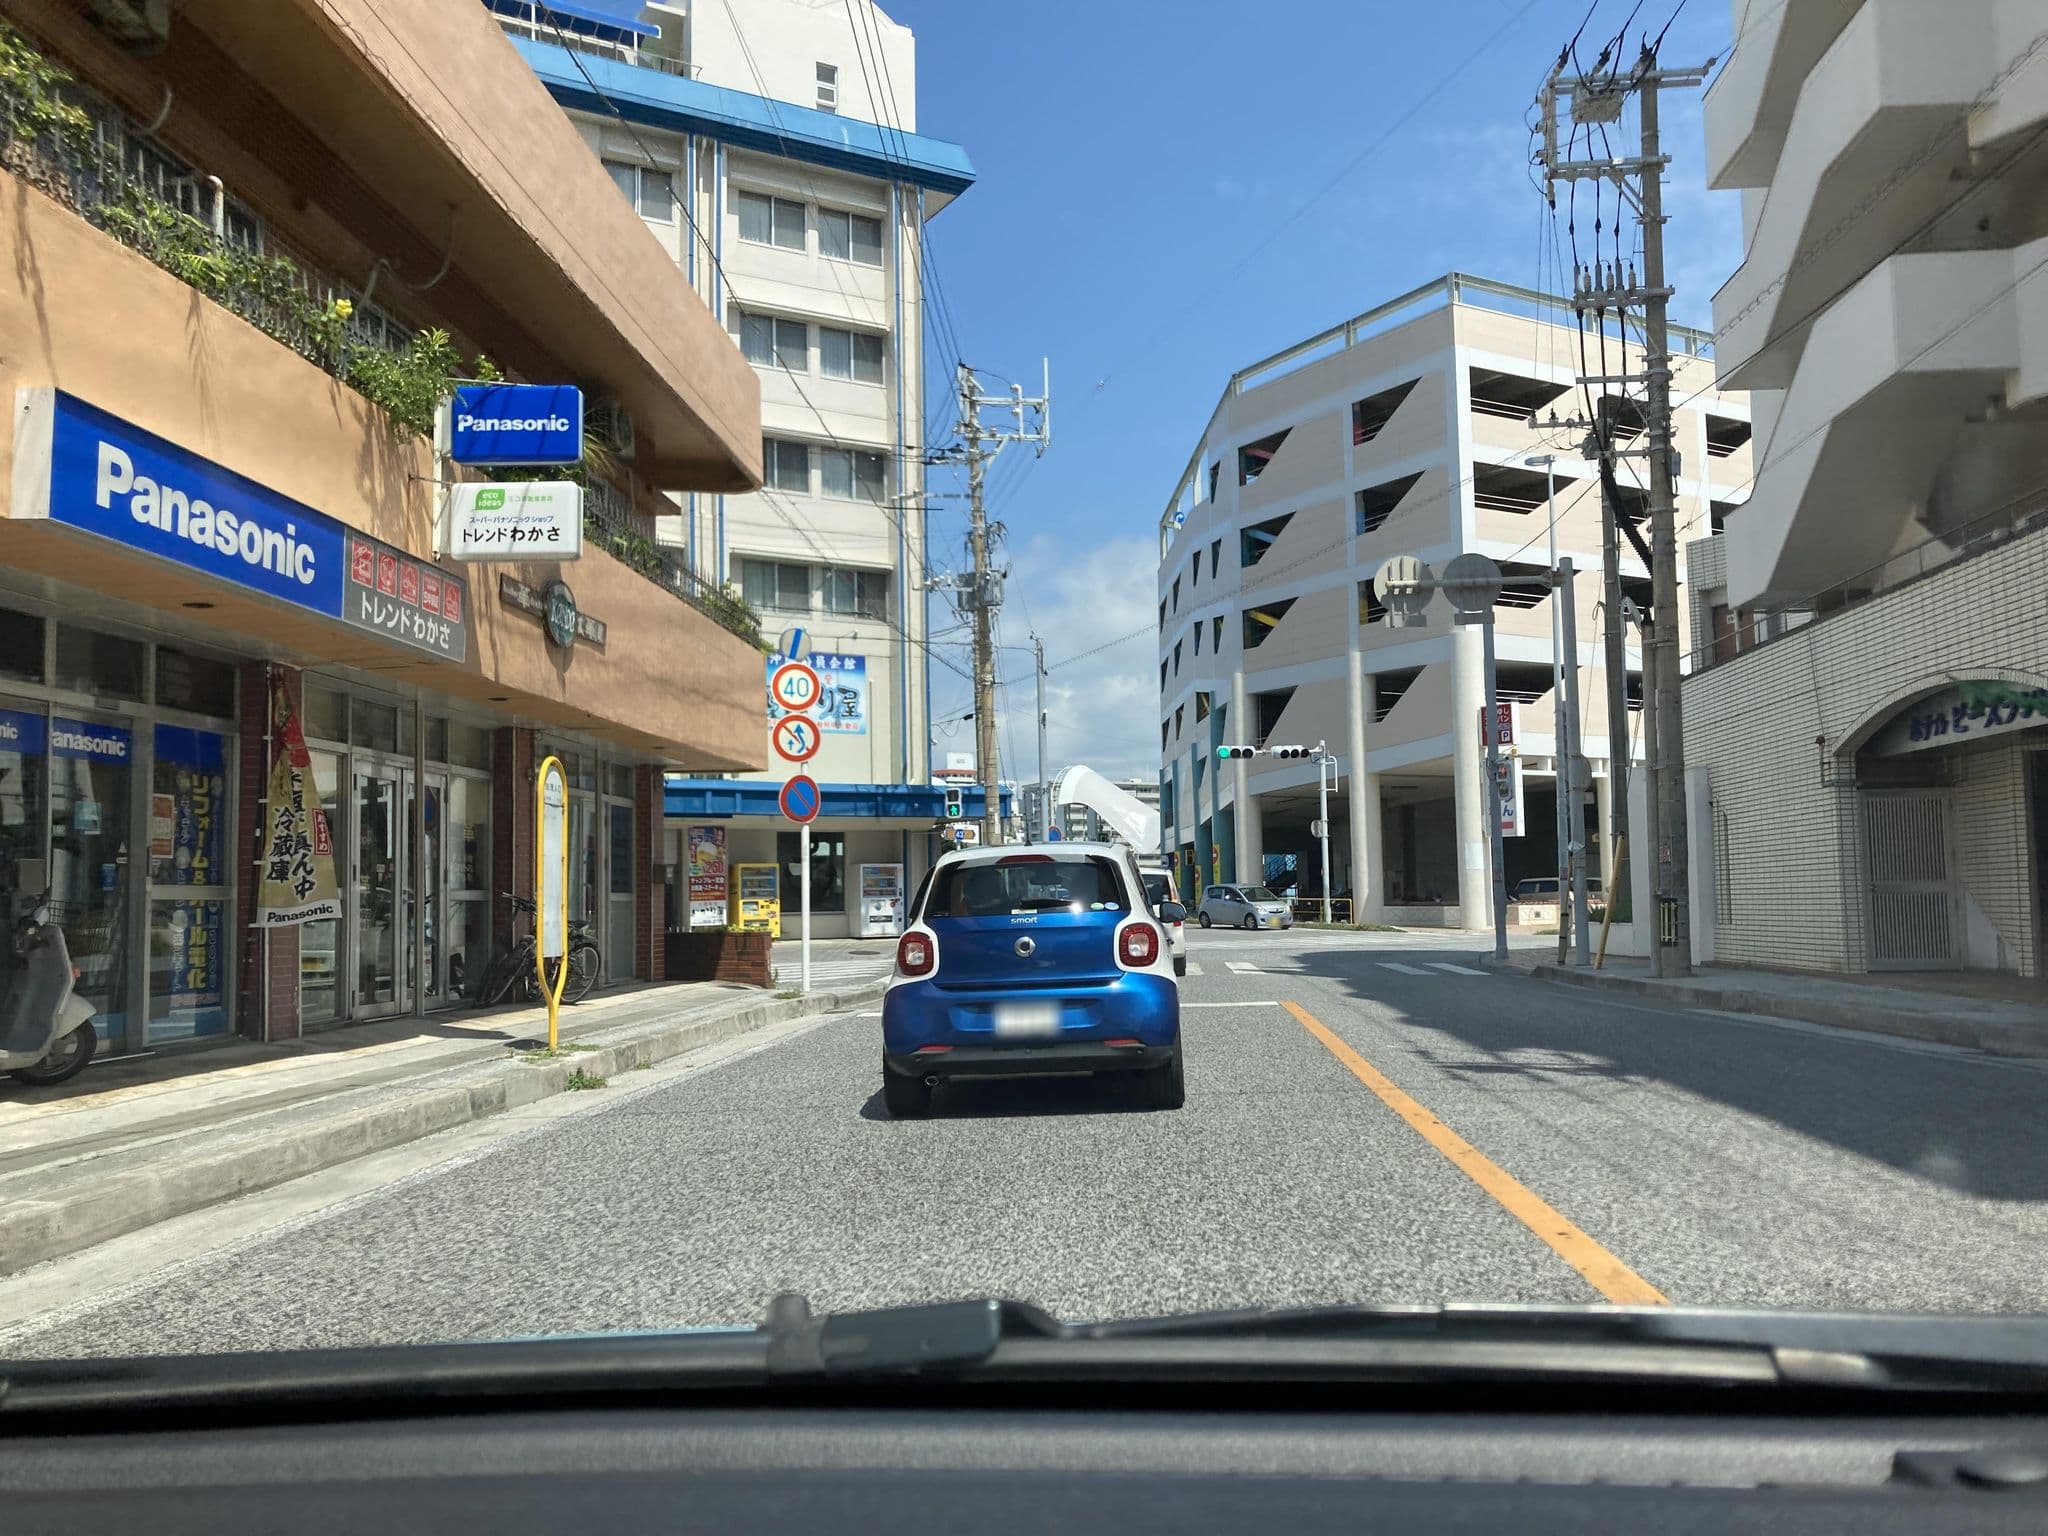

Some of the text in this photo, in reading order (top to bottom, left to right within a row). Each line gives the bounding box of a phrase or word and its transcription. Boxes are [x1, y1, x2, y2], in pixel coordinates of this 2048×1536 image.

[457, 413, 570, 433] Panasonic
[96, 439, 316, 585] Panasonic
[478, 497, 501, 507] ideas
[463, 526, 561, 543] トレンドわかさ
[361, 591, 451, 650] トレンドわかさ
[783, 677, 809, 697] 40
[52, 731, 126, 757] anasonic
[265, 806, 297, 884] 冷蔵庫
[266, 903, 334, 923] Panasonic
[1010, 916, 1038, 925] smart
